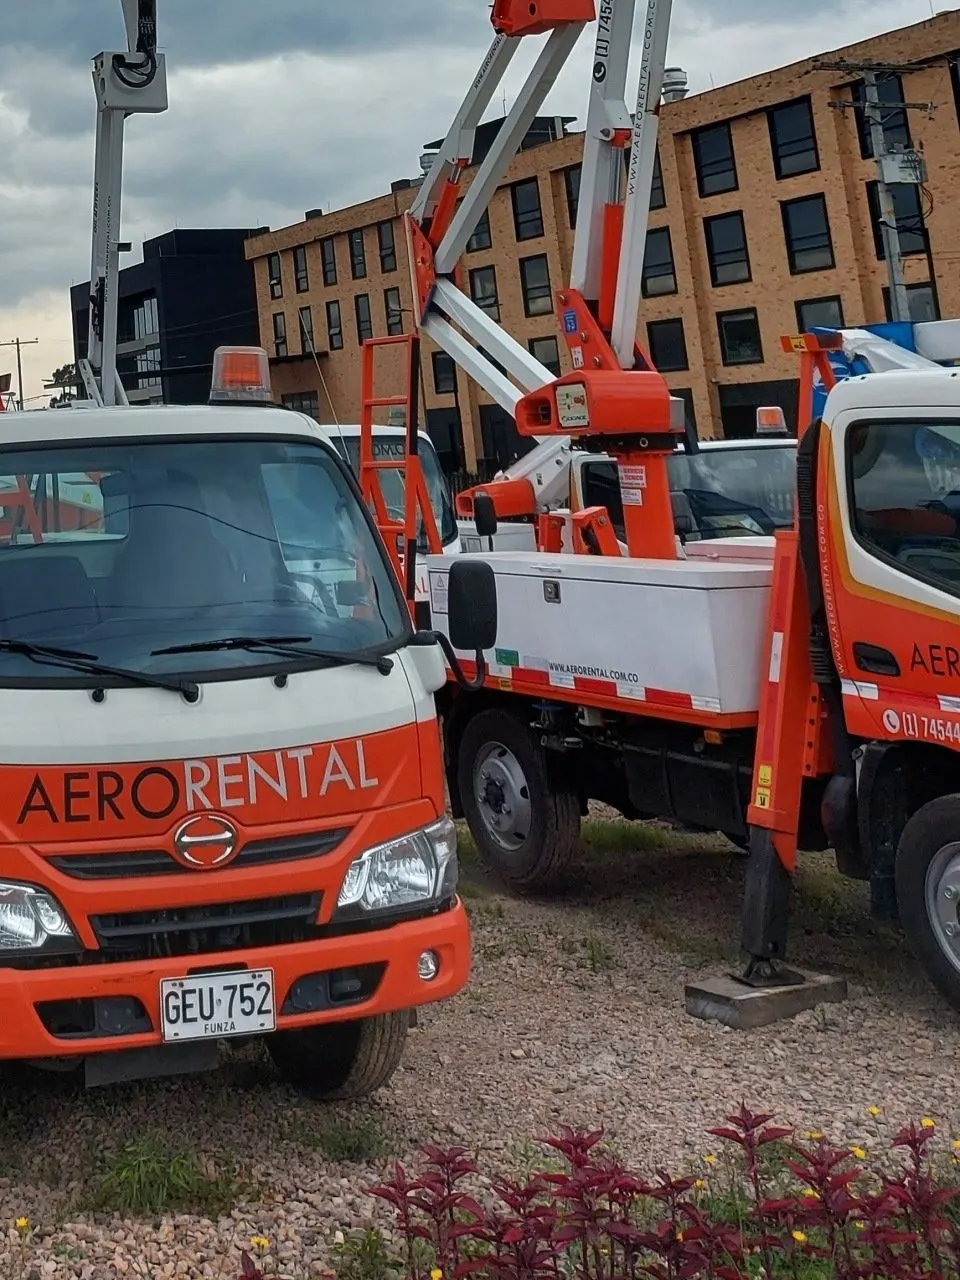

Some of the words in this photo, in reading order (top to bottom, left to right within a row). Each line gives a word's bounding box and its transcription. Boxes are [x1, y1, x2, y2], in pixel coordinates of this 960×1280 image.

[595, 39, 610, 58] (1)
[818, 504, 845, 674] WWW.AERORENTAL.COM.CO
[548, 662, 639, 683] WWW.AERORENTAL.COM.CO
[910, 641, 960, 677] AER
[902, 711, 919, 738] (1)
[16, 739, 379, 825] AERORENTAL
[164, 986, 215, 1025] GEU
[222, 981, 272, 1019] 752
[204, 1021, 236, 1034] FUNZA
